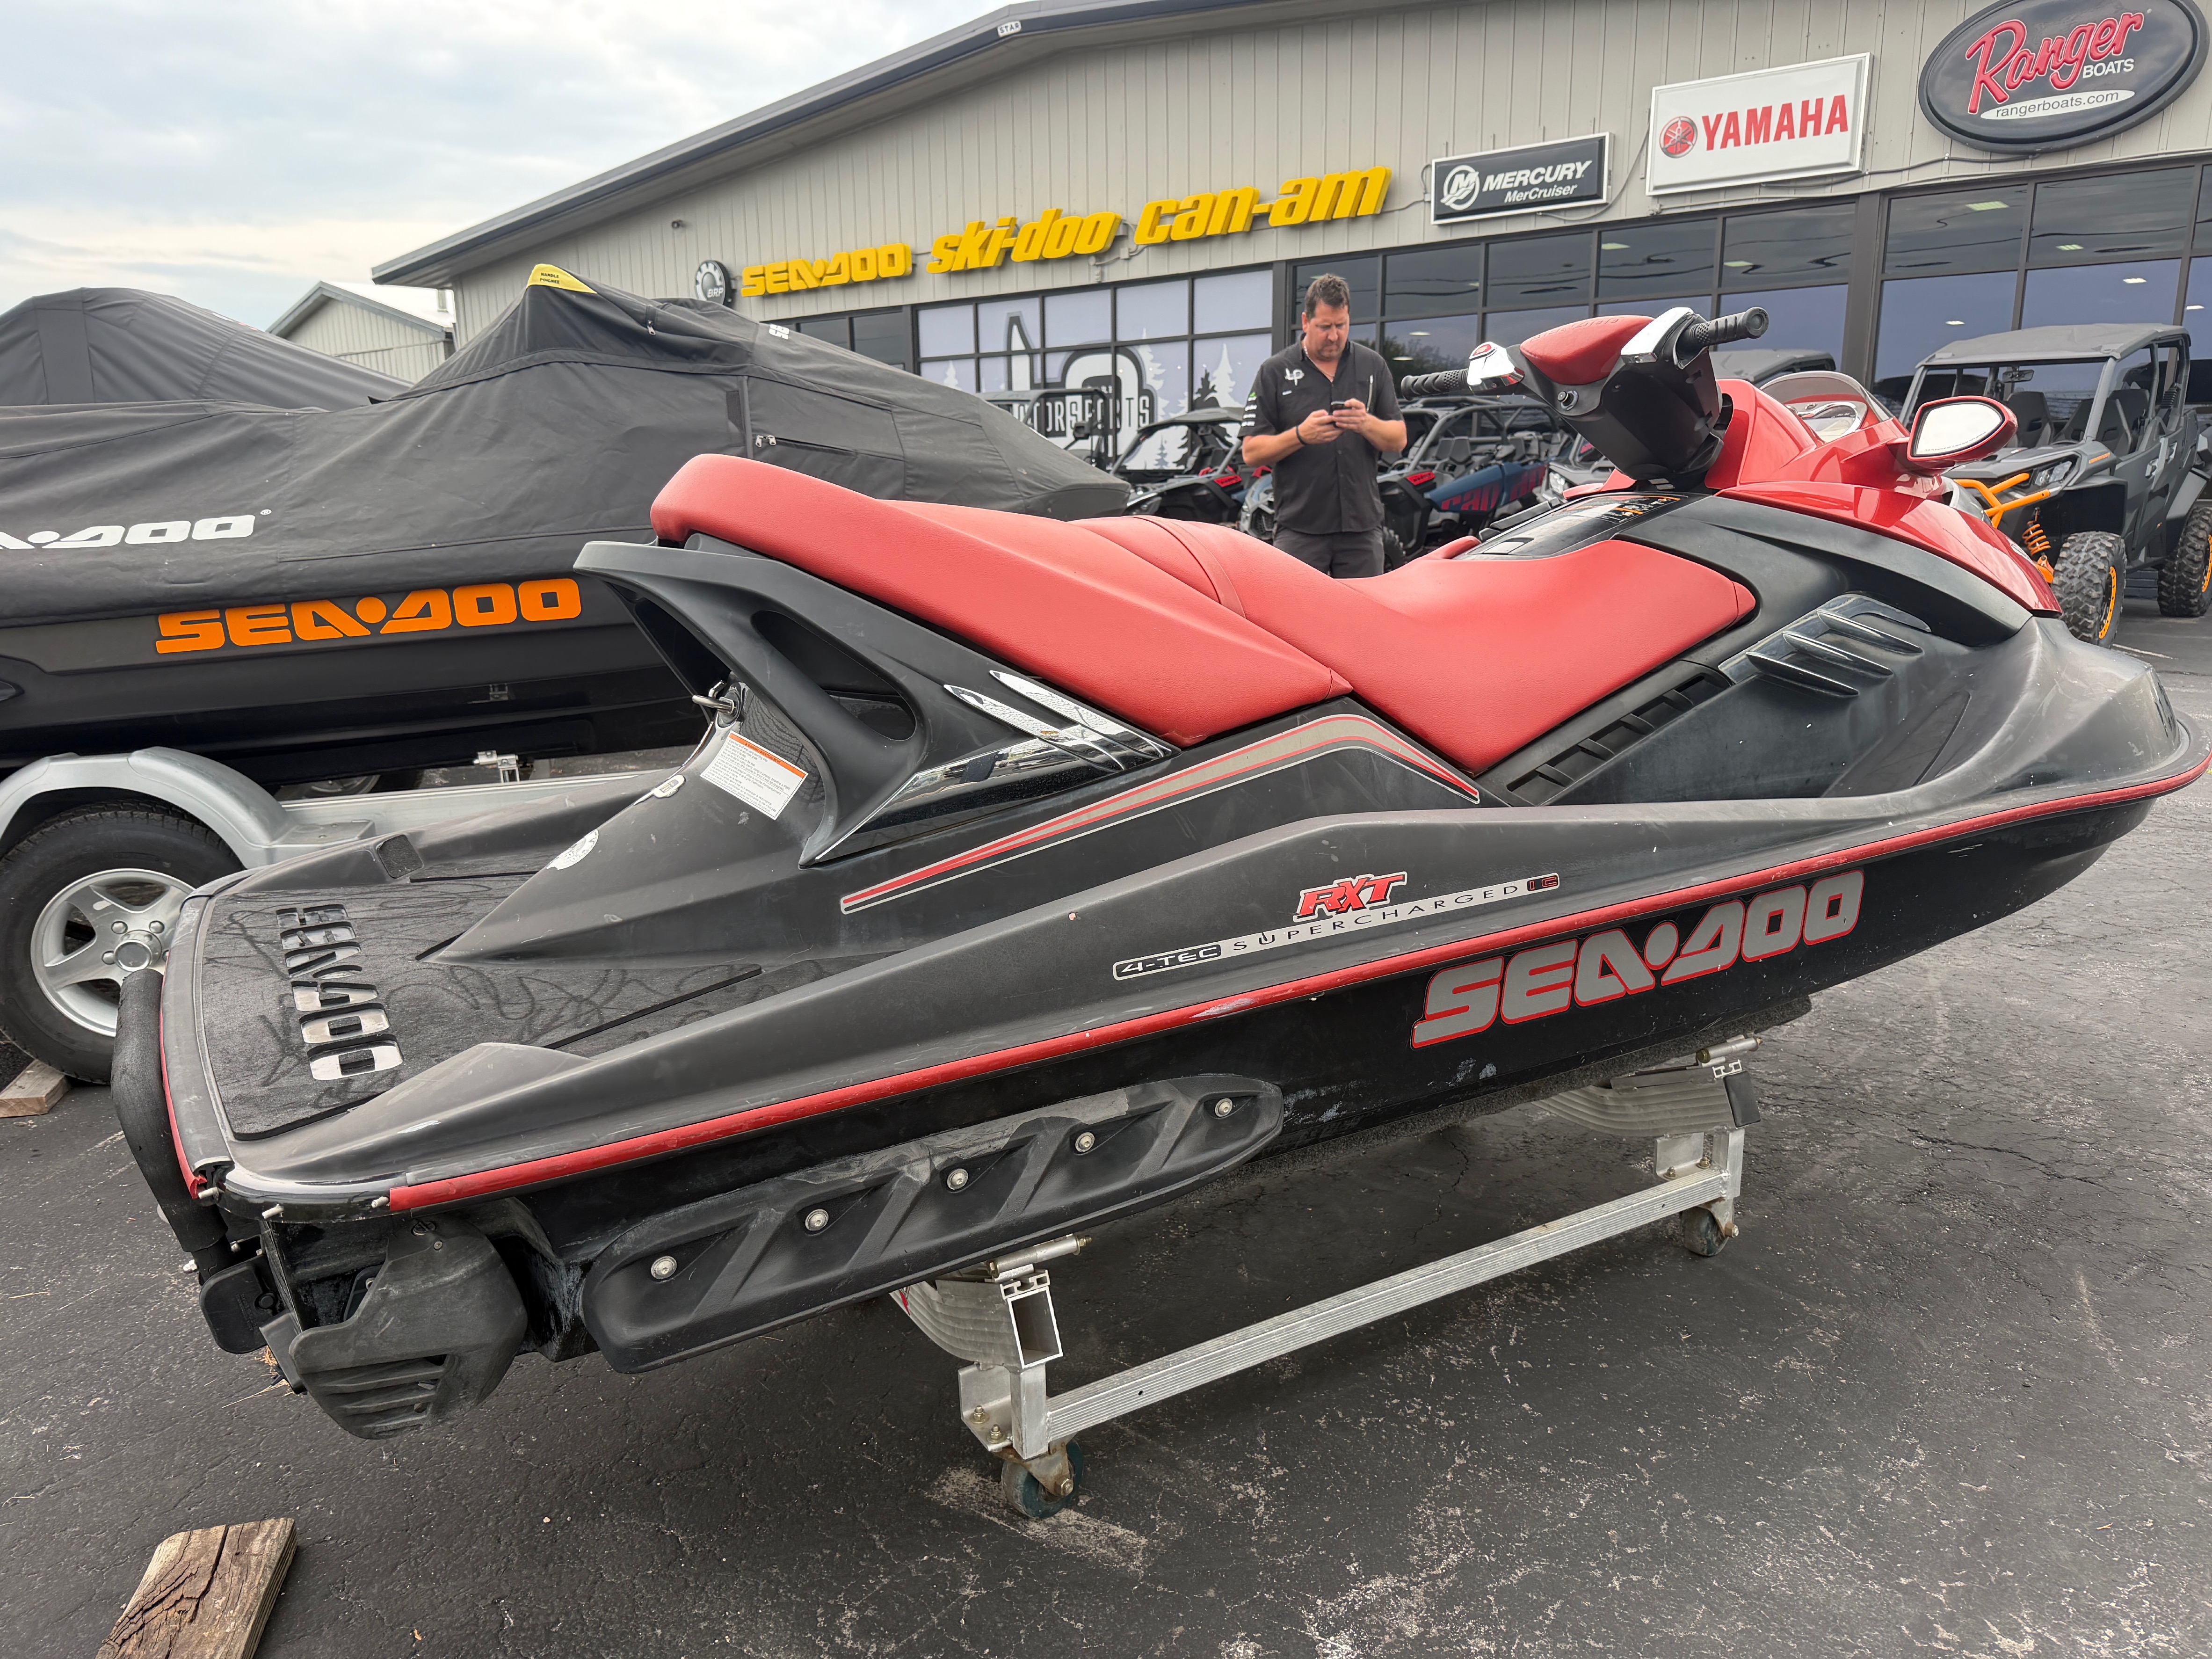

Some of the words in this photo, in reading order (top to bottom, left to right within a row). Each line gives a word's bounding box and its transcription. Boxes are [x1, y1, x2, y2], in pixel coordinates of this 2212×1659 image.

[999, 22, 1019, 34] STAR
[1965, 12, 2144, 115] Ranger
[2082, 58, 2134, 78] BOATS
[1996, 92, 2119, 118] rangerboats.com
[1702, 94, 1848, 151] YAMAHA
[1482, 160, 1592, 192] MERCURY
[1504, 184, 1578, 204] MerCruiser
[926, 208, 1122, 274] ski-doo
[1133, 166, 1392, 245] can-am
[707, 287, 725, 298] BRP
[1295, 873, 1406, 920] RXT
[1121, 946, 1218, 974] 4-TEC
[1233, 885, 1518, 951] SUPERCHARGED
